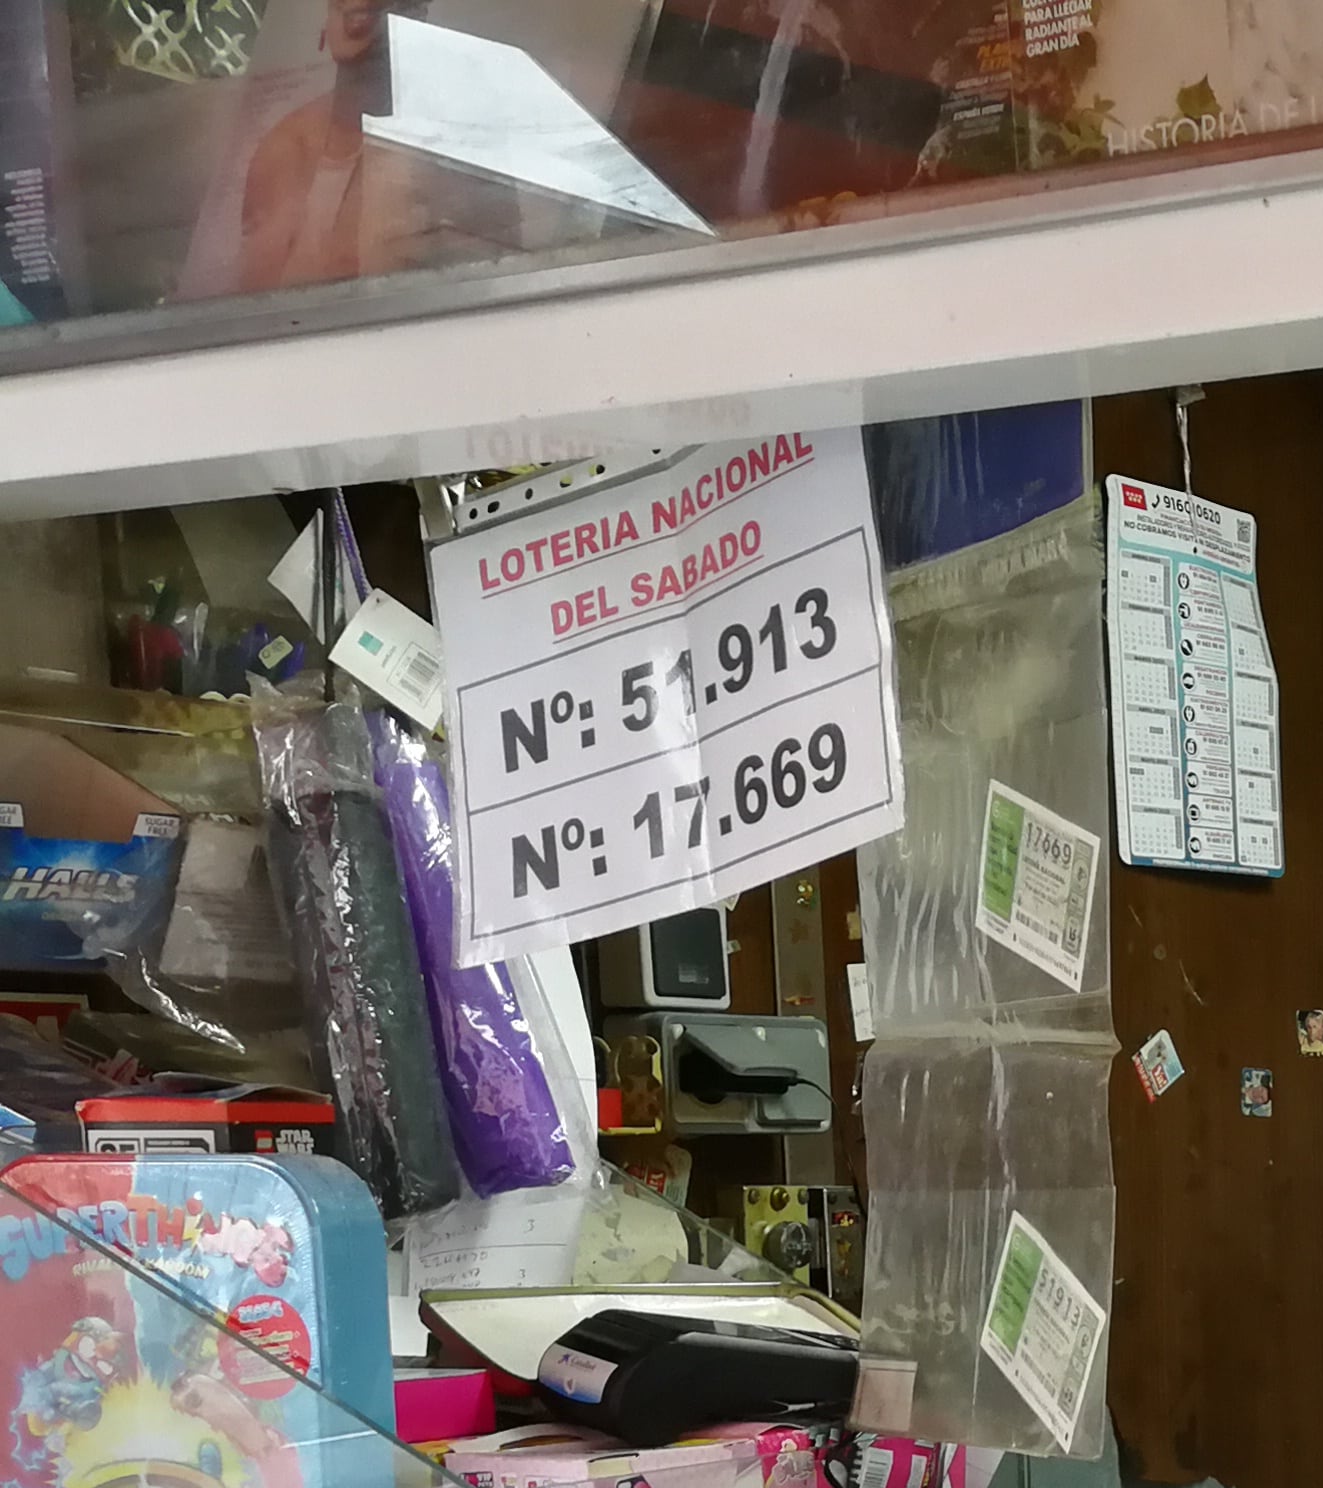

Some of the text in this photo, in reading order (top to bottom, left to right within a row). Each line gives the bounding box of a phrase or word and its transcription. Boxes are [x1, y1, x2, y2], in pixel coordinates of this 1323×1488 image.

[1026, 38, 1059, 59] GRAN
[1107, 113, 1247, 157] HISTORIA
[479, 511, 638, 590] LOTERIA
[651, 433, 814, 533] NACIONAL
[551, 521, 761, 635] DEL SABADO
[621, 587, 838, 732] 51.913
[633, 722, 847, 858] 17.669
[1026, 823, 1072, 866] 17669
[3, 866, 139, 903] HALLS
[1039, 1268, 1081, 1330] 51913
